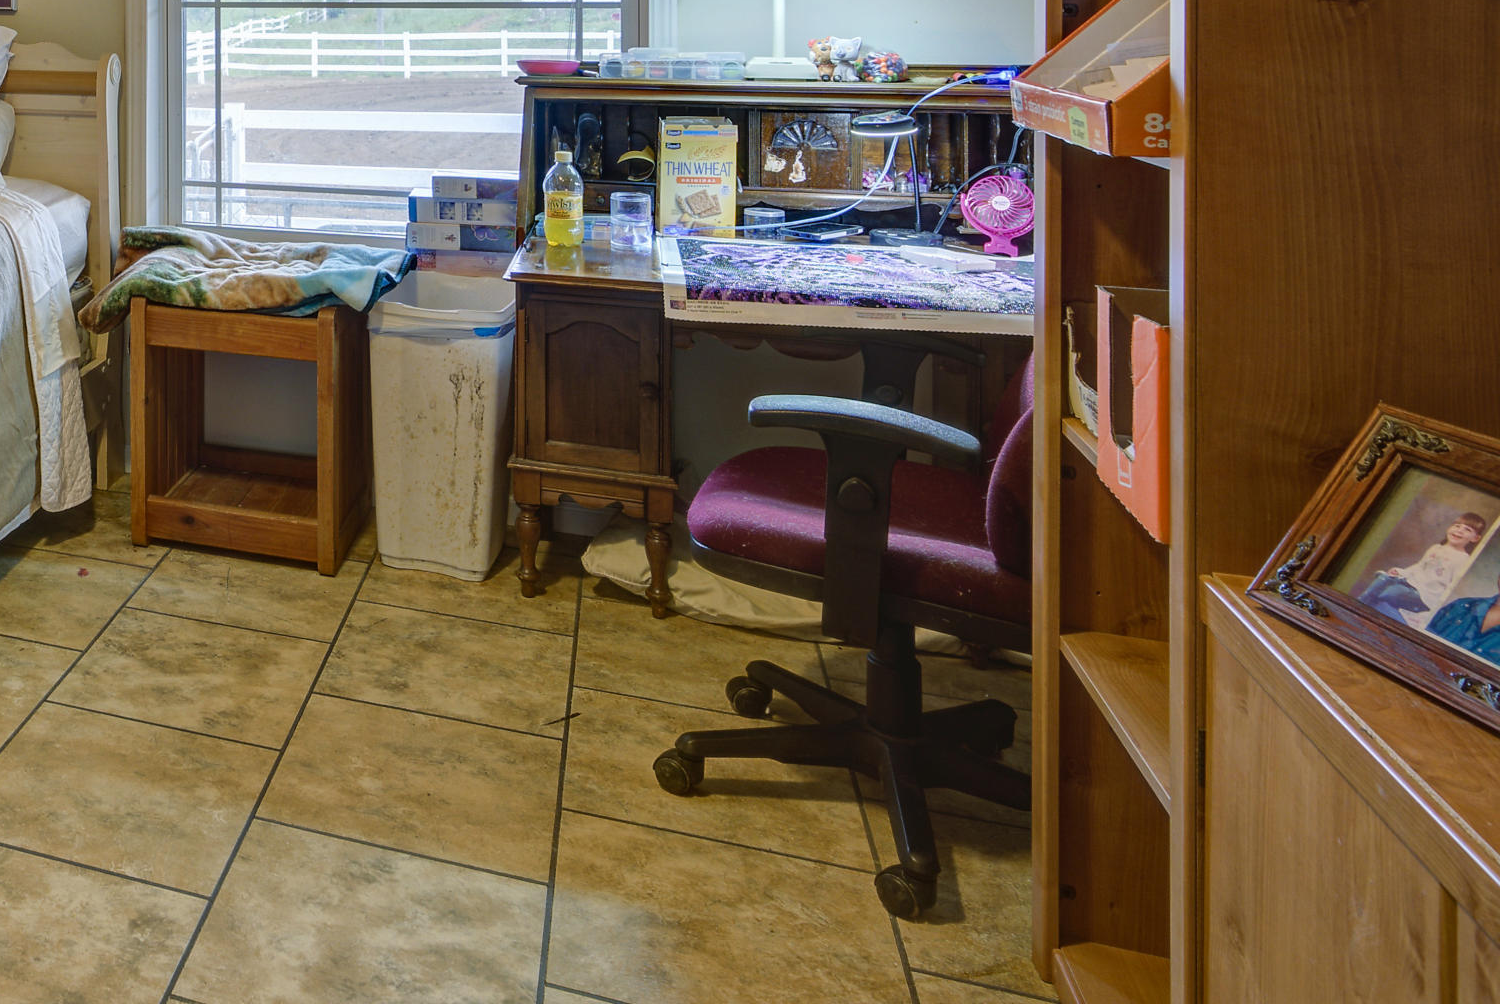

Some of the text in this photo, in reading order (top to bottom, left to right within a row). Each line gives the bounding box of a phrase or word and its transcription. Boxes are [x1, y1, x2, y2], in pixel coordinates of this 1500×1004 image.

[1143, 136, 1170, 149] Ca
[665, 161, 733, 176] THIN WHEAT
